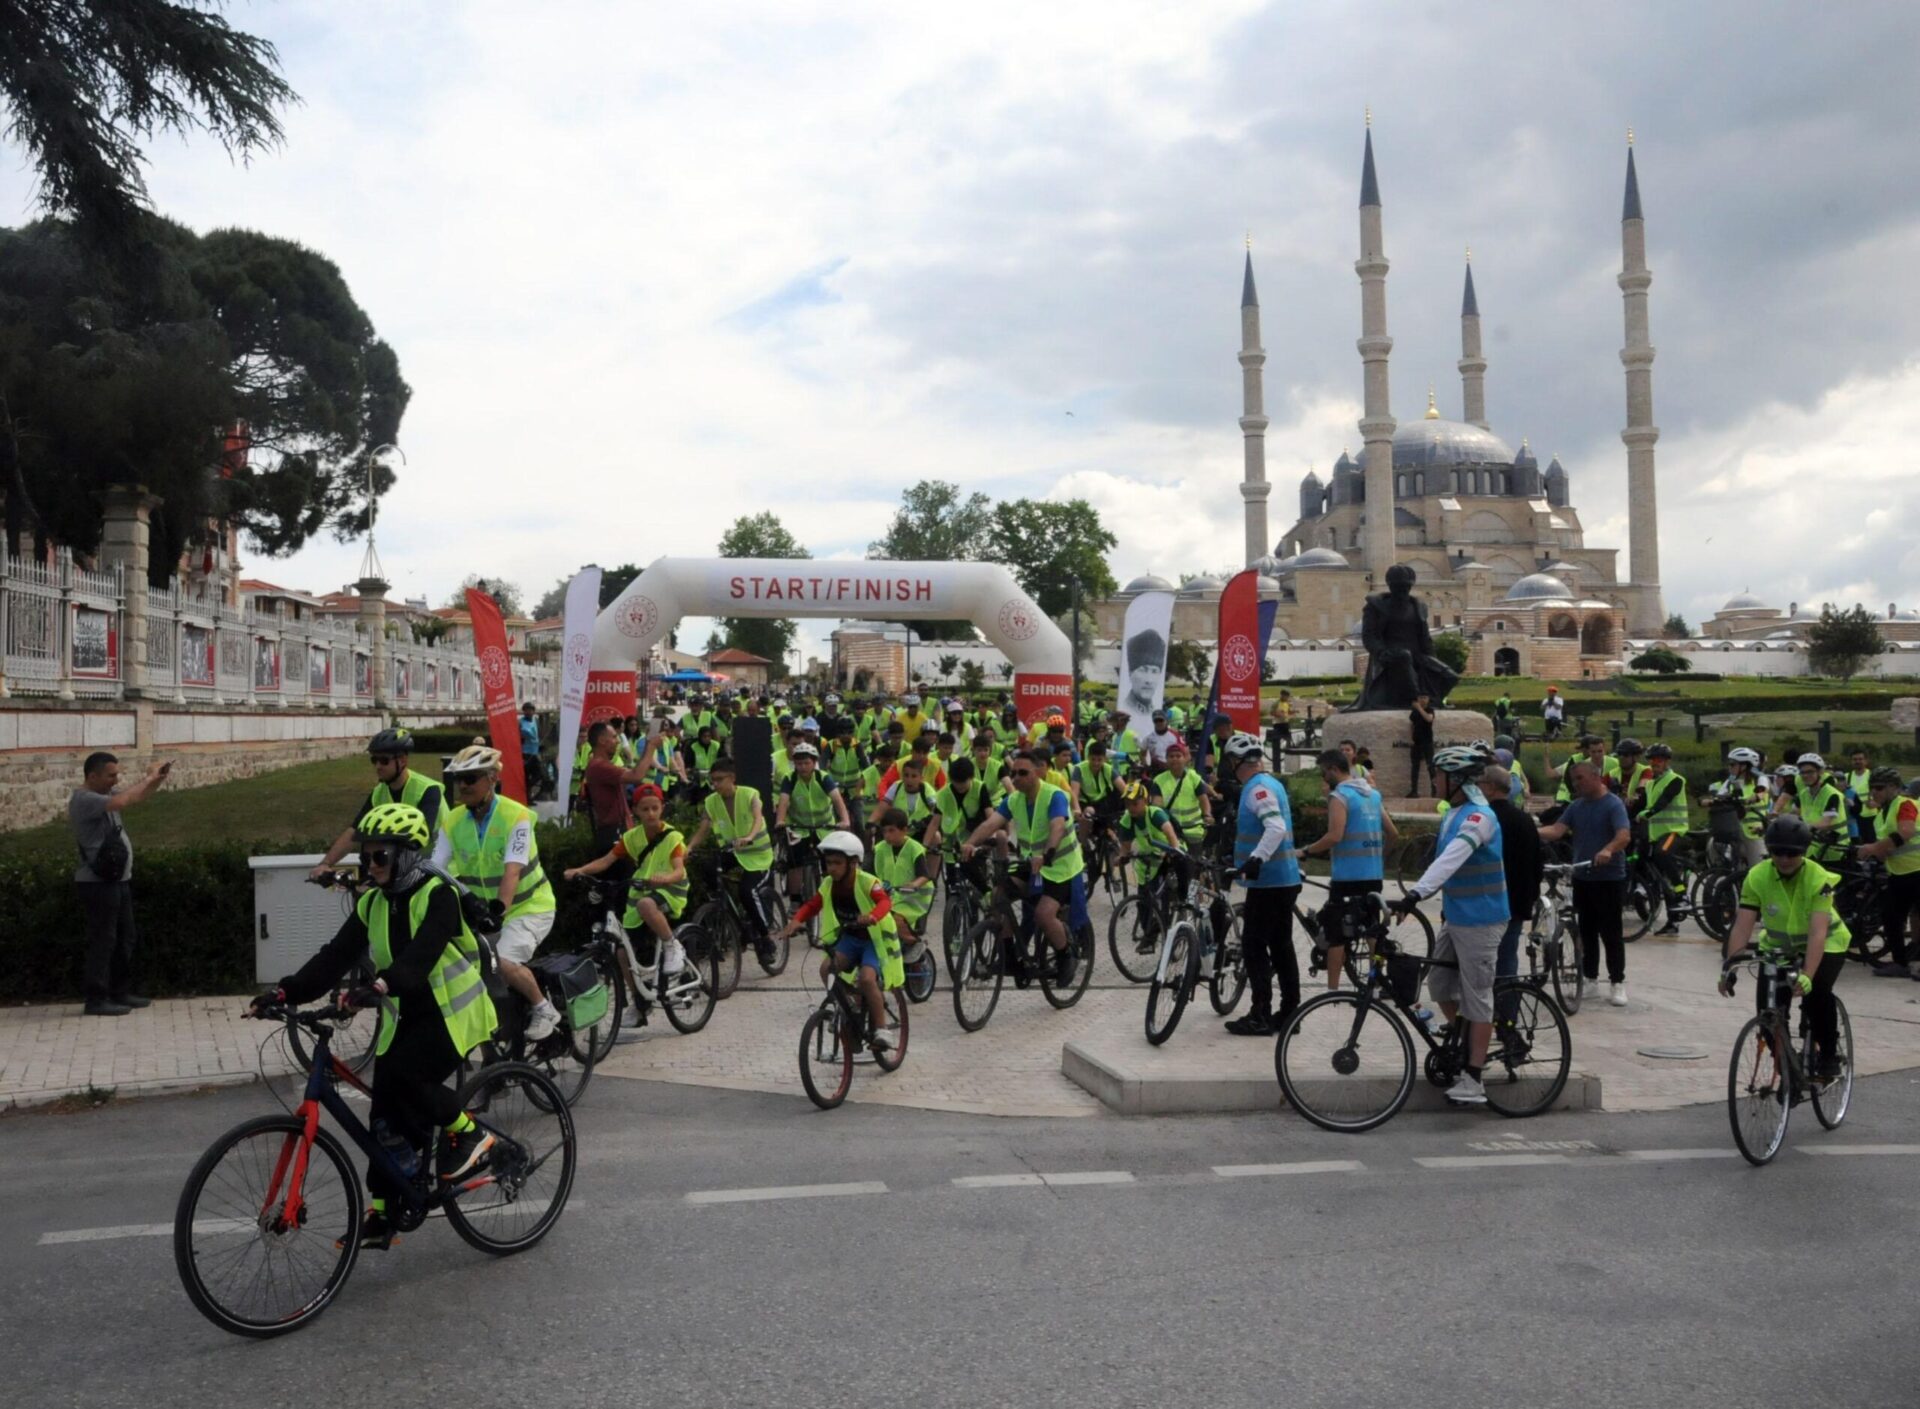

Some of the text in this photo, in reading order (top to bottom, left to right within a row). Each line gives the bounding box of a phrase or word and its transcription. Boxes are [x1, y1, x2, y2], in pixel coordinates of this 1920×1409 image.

[730, 577, 931, 601] START/FINISH
[587, 680, 631, 693] DİRNE
[1022, 682, 1070, 696] EDİRNE
